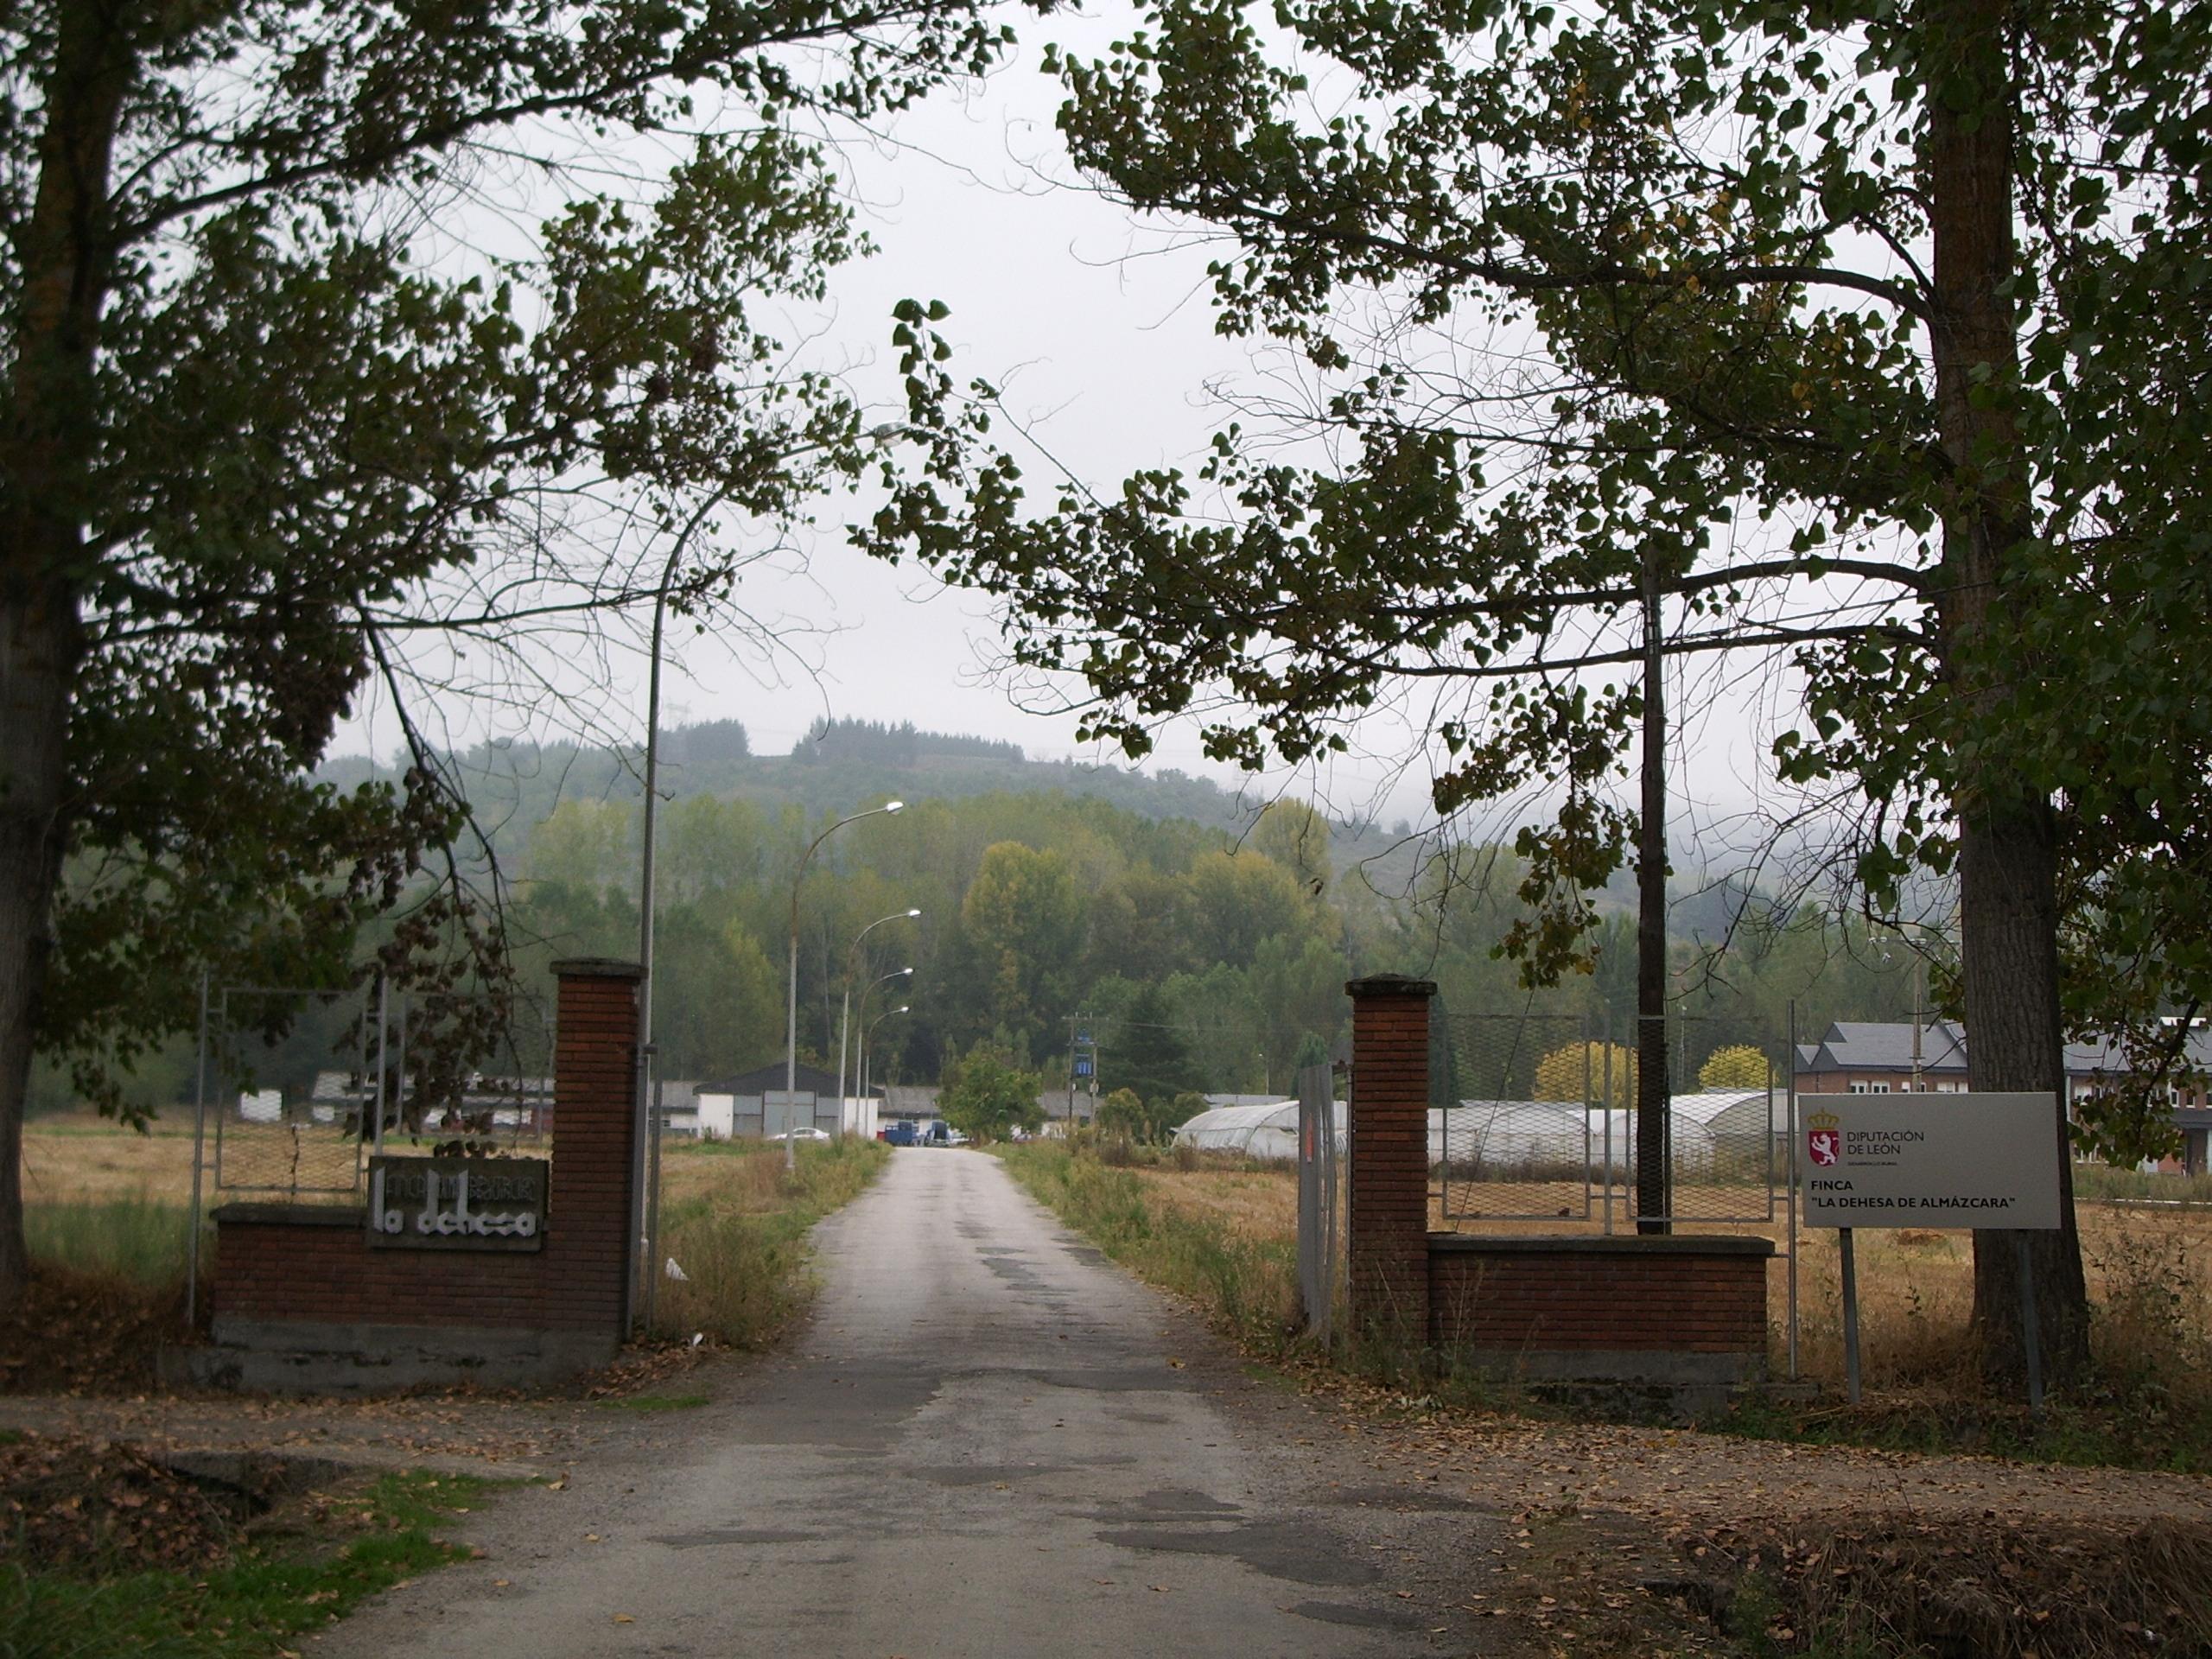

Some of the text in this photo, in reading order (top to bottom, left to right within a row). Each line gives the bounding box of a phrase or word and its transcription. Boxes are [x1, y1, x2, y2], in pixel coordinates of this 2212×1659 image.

[1847, 1129, 1924, 1141] DIPUTACIÓN
[1847, 1142, 1901, 1154] DE LEÓN
[1810, 1180, 1853, 1192] FINCA
[417, 1168, 537, 1236] dehesa
[1811, 1195, 2016, 1209] "LA DEHESA DE ALMÁZCARA"
